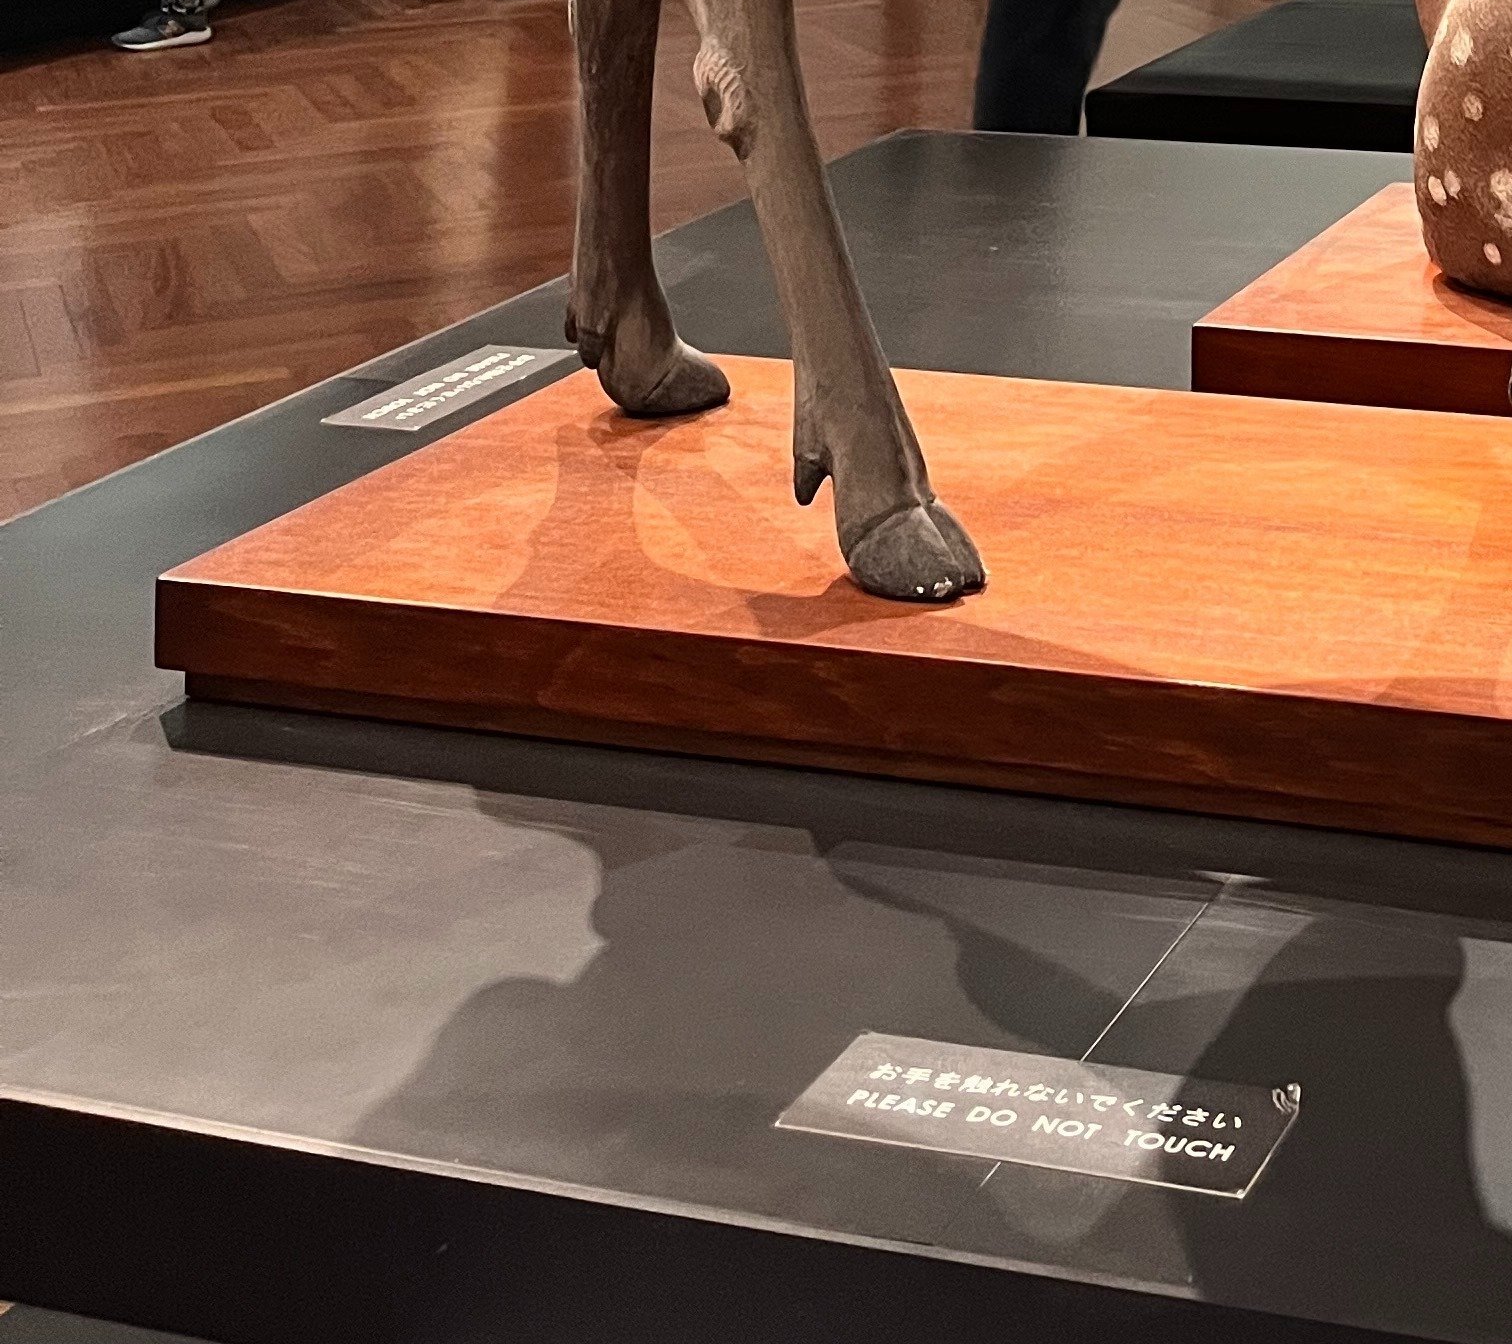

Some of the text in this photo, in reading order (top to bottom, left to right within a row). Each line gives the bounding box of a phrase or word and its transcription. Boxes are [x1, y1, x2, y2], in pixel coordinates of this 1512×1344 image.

[846, 1088, 1236, 1162] PLEASE DO NOT TOUCH
[868, 1062, 1242, 1129] お手を触れないでください
